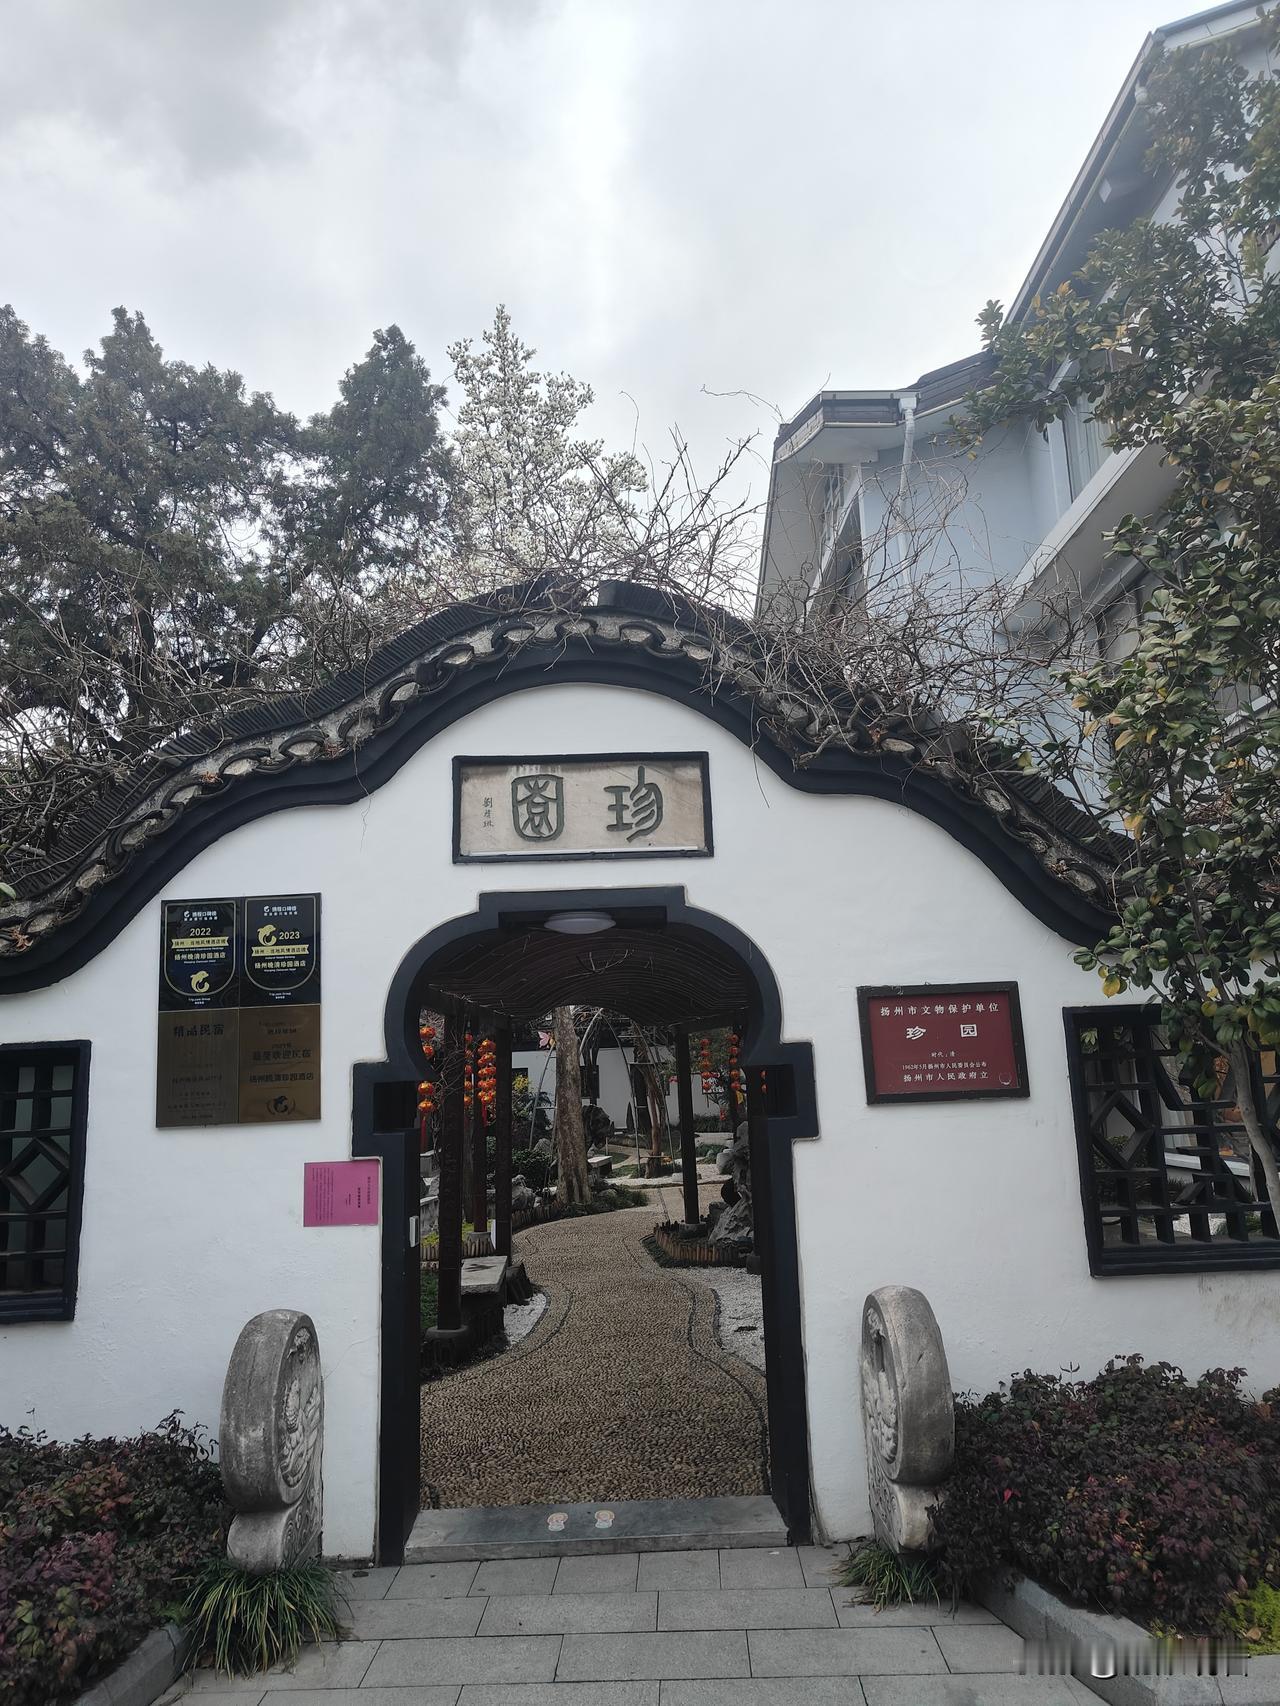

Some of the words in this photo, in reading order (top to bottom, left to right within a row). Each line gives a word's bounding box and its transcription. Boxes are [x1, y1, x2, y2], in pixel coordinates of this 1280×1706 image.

[190, 928, 211, 936] 2022
[279, 931, 300, 940] 2023
[880, 1003, 1000, 1016] 扬州市文物保护单位
[903, 1071, 988, 1082] 扬州市人民政府立
